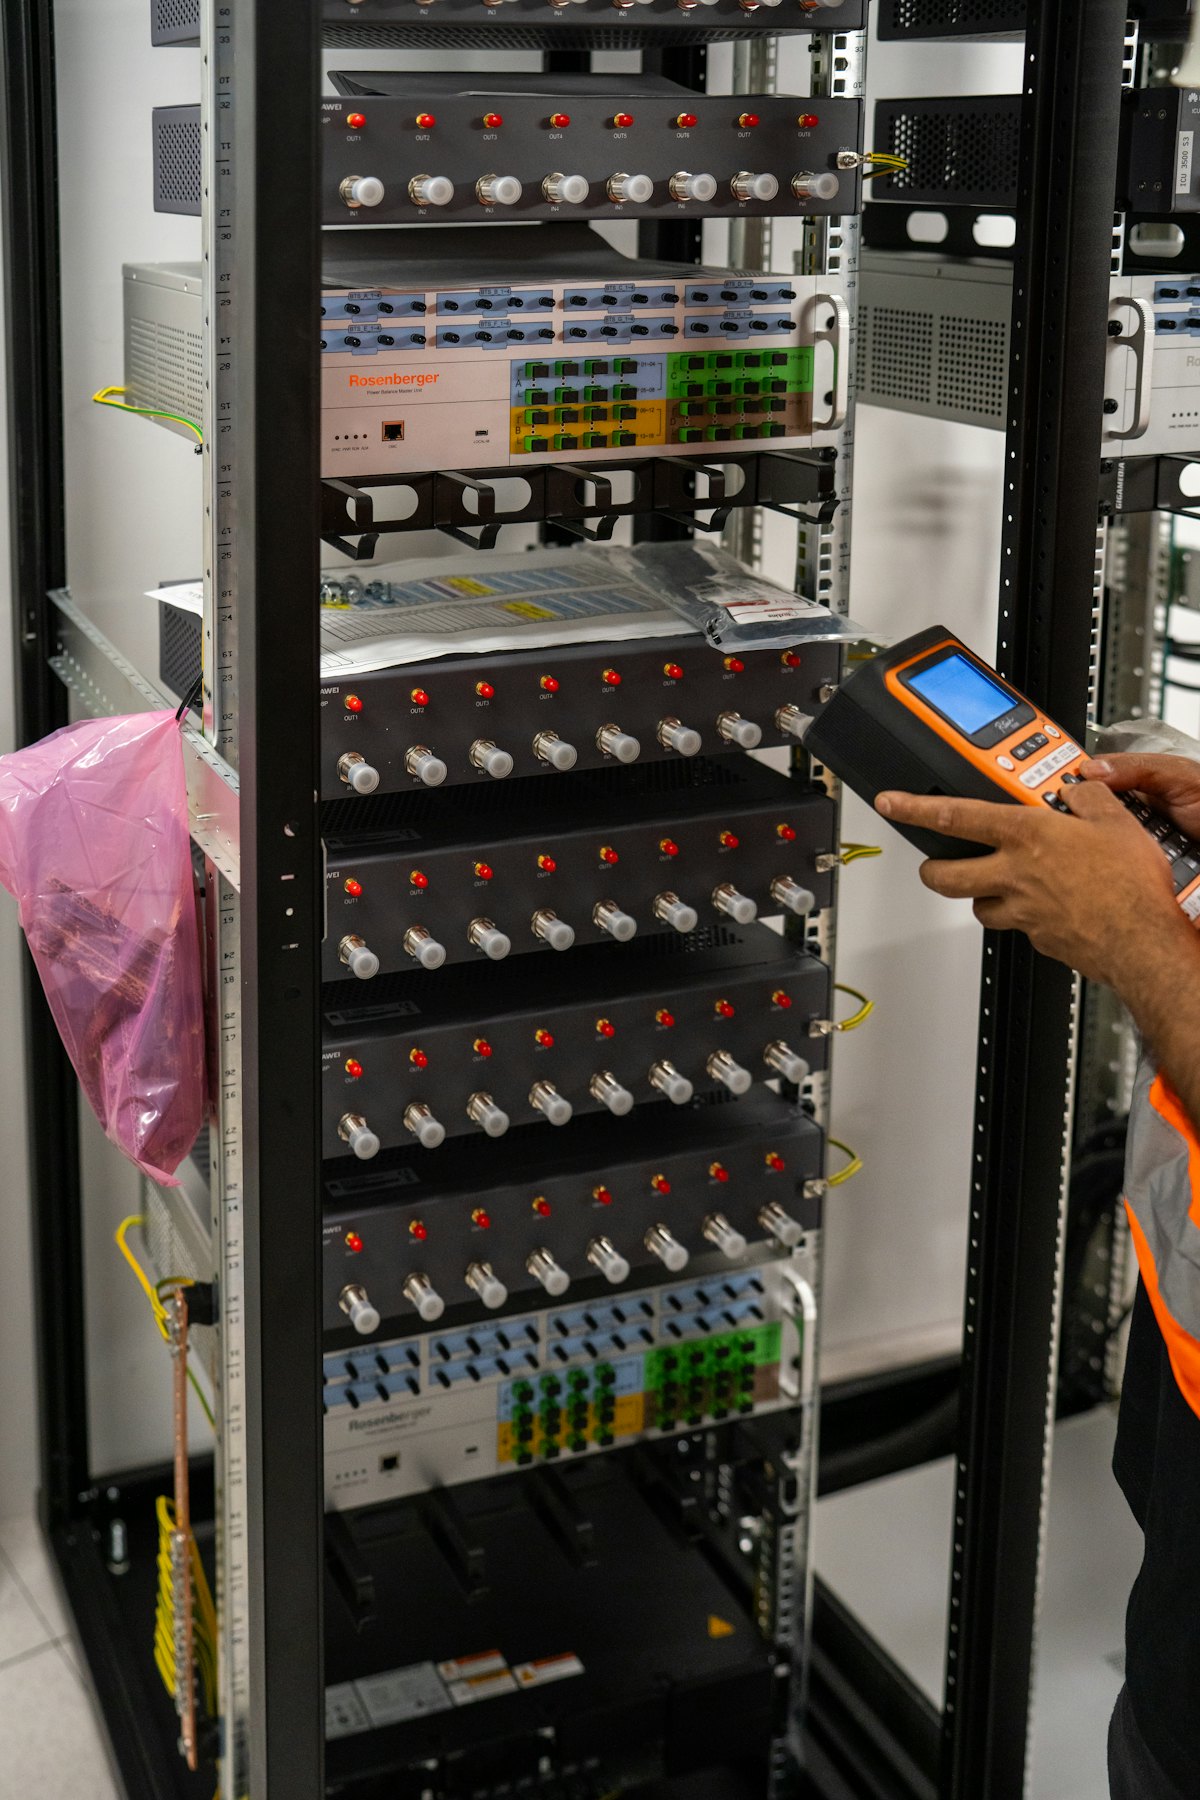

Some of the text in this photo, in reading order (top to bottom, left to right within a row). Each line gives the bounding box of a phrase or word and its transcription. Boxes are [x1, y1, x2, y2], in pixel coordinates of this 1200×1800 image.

[218, 36, 231, 44] 33
[219, 101, 231, 109] 32
[1182, 136, 1190, 147] S3
[1181, 150, 1189, 169] 3500
[220, 168, 231, 176] 31
[219, 362, 231, 370] 28
[670, 371, 677, 380] C
[349, 373, 439, 387] Rosenberger
[515, 379, 522, 387] A
[220, 425, 232, 433] 27
[515, 426, 521, 434] B
[1116, 462, 1125, 509] GIGAMEDIA
[220, 490, 232, 498] 26
[222, 736, 234, 744] 22
[409, 888, 424, 896] OUT2
[223, 916, 234, 924] 19
[224, 976, 235, 984] 18
[225, 1034, 236, 1042] 17
[225, 1092, 236, 1100] 16
[348, 1405, 432, 1431] Rosenberger
